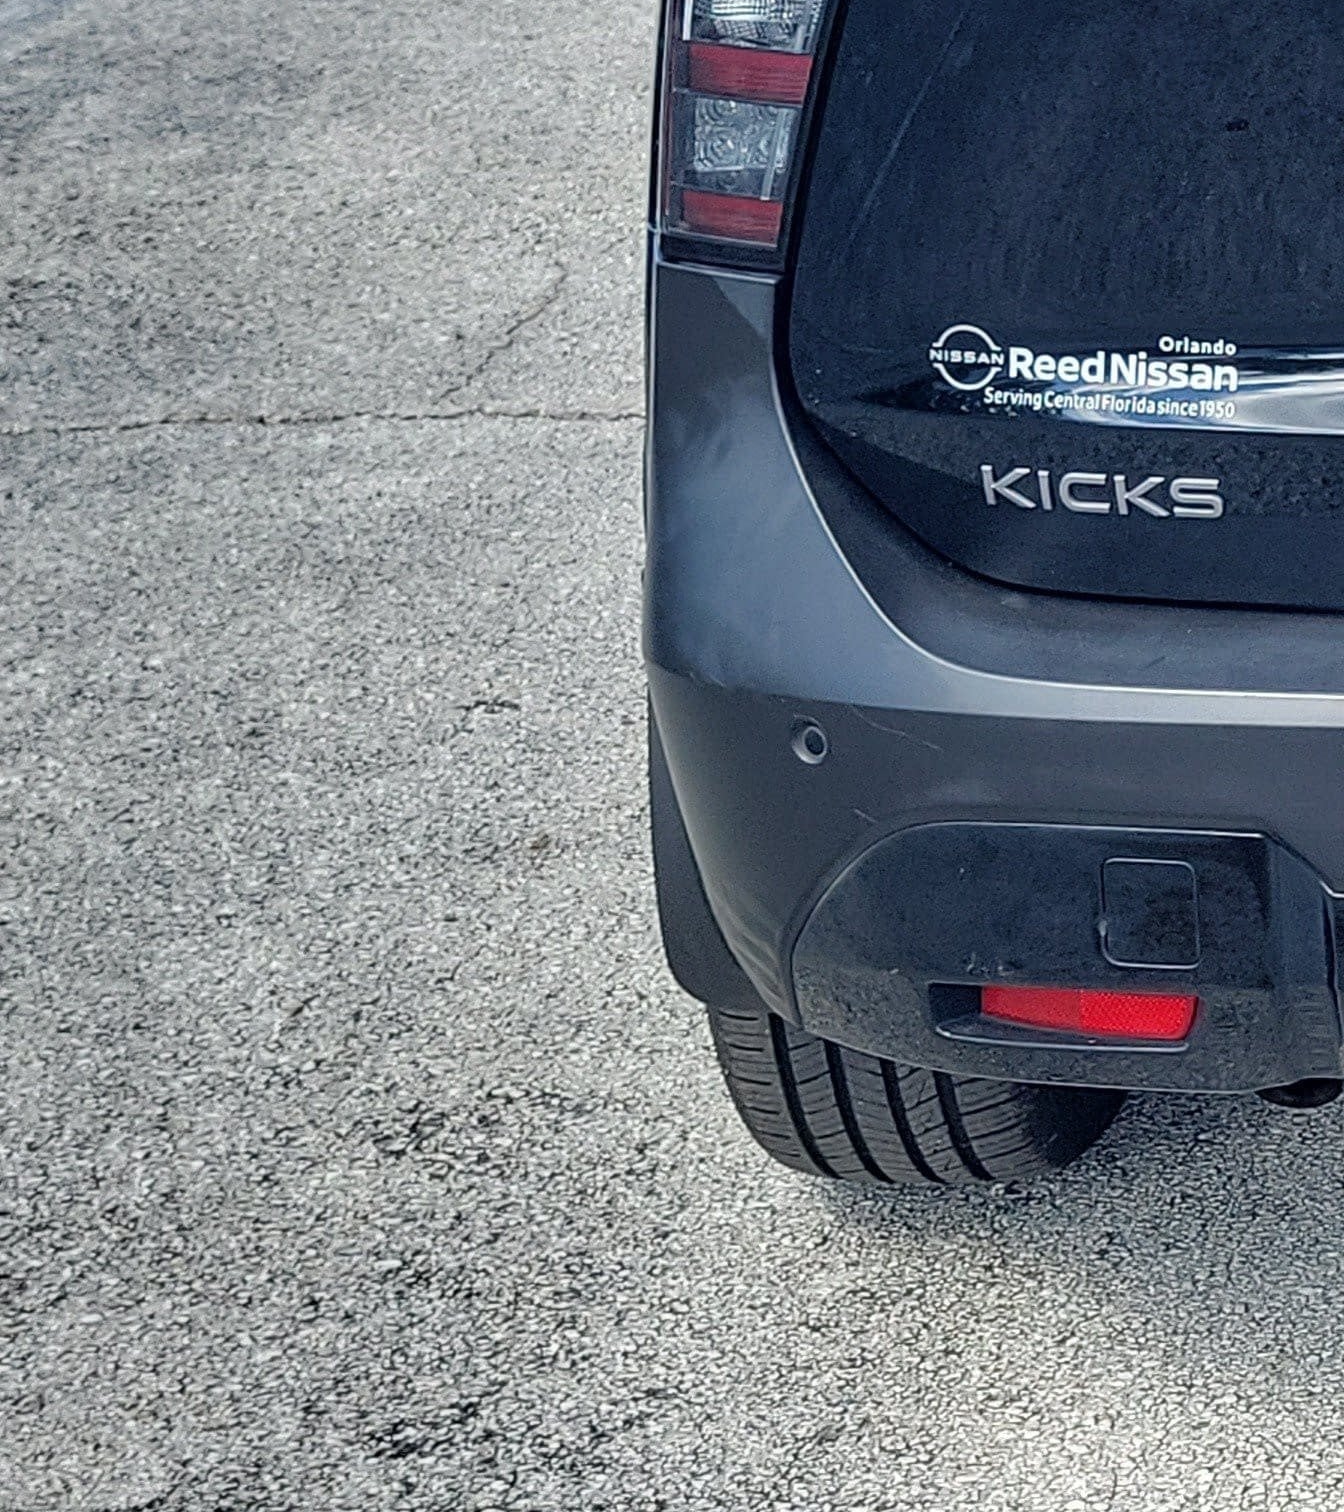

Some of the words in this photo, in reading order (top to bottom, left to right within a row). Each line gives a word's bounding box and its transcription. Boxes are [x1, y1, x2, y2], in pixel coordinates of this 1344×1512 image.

[929, 348, 1006, 366] NISSAN
[1158, 336, 1238, 356] Orlando
[1008, 346, 1106, 384] Reed
[1110, 351, 1239, 392] Nissan
[983, 386, 1042, 411] Serving
[1044, 390, 1100, 411] Central
[1101, 395, 1156, 414] Florida
[1157, 397, 1198, 417] since
[1199, 400, 1236, 419] 1950
[980, 464, 1224, 519] KICKS
